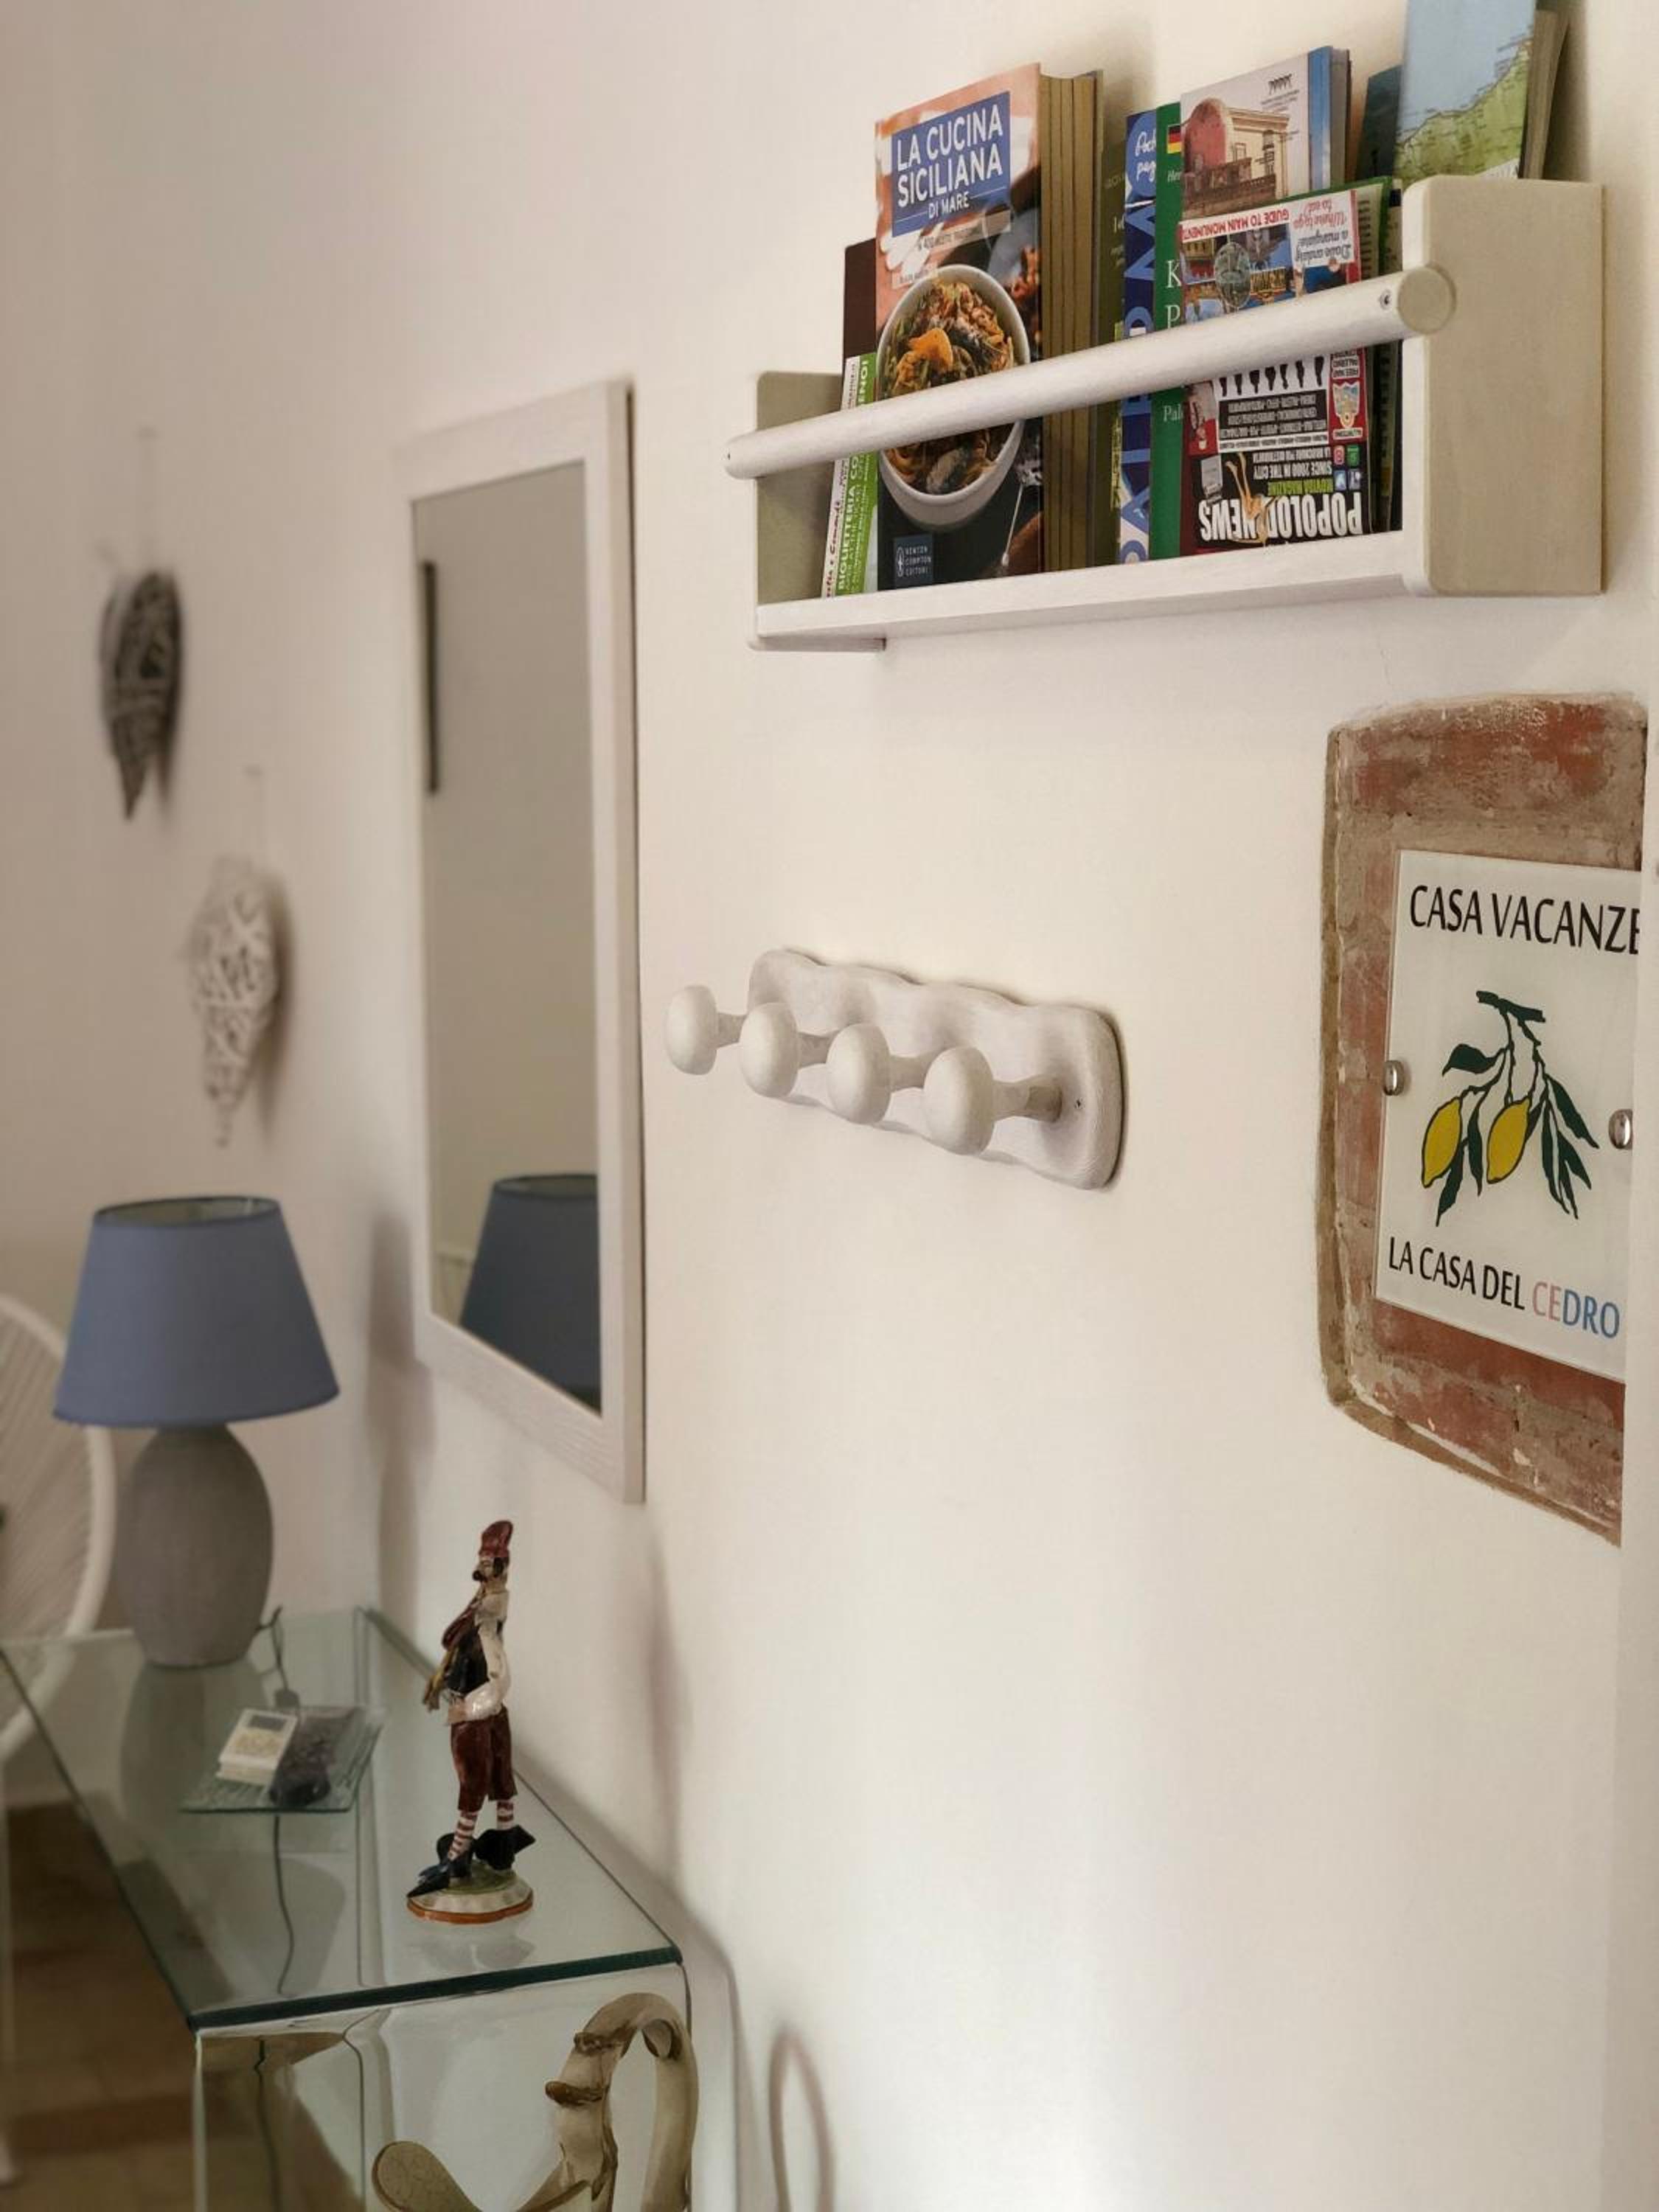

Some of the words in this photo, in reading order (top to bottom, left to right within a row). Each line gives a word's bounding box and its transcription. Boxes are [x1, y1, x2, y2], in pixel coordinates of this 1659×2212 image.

[897, 133, 921, 171] LA
[927, 104, 1003, 160] CUCINA
[898, 143, 1003, 207] SICILIANA
[928, 201, 939, 218] DI
[942, 191, 970, 214] MARE
[1228, 216, 1248, 230] MAIN
[1250, 214, 1262, 226] TO
[1264, 209, 1289, 220] GUIDE
[838, 485, 856, 591] BIGLIETTERIA
[1411, 885, 1482, 934] CASA
[1492, 893, 1640, 955] VACANZE
[1388, 1237, 1413, 1275] LA
[1419, 1248, 1476, 1295] CASA
[1482, 1265, 1526, 1310] DEL
[1532, 1281, 1620, 1338] CEDRO
